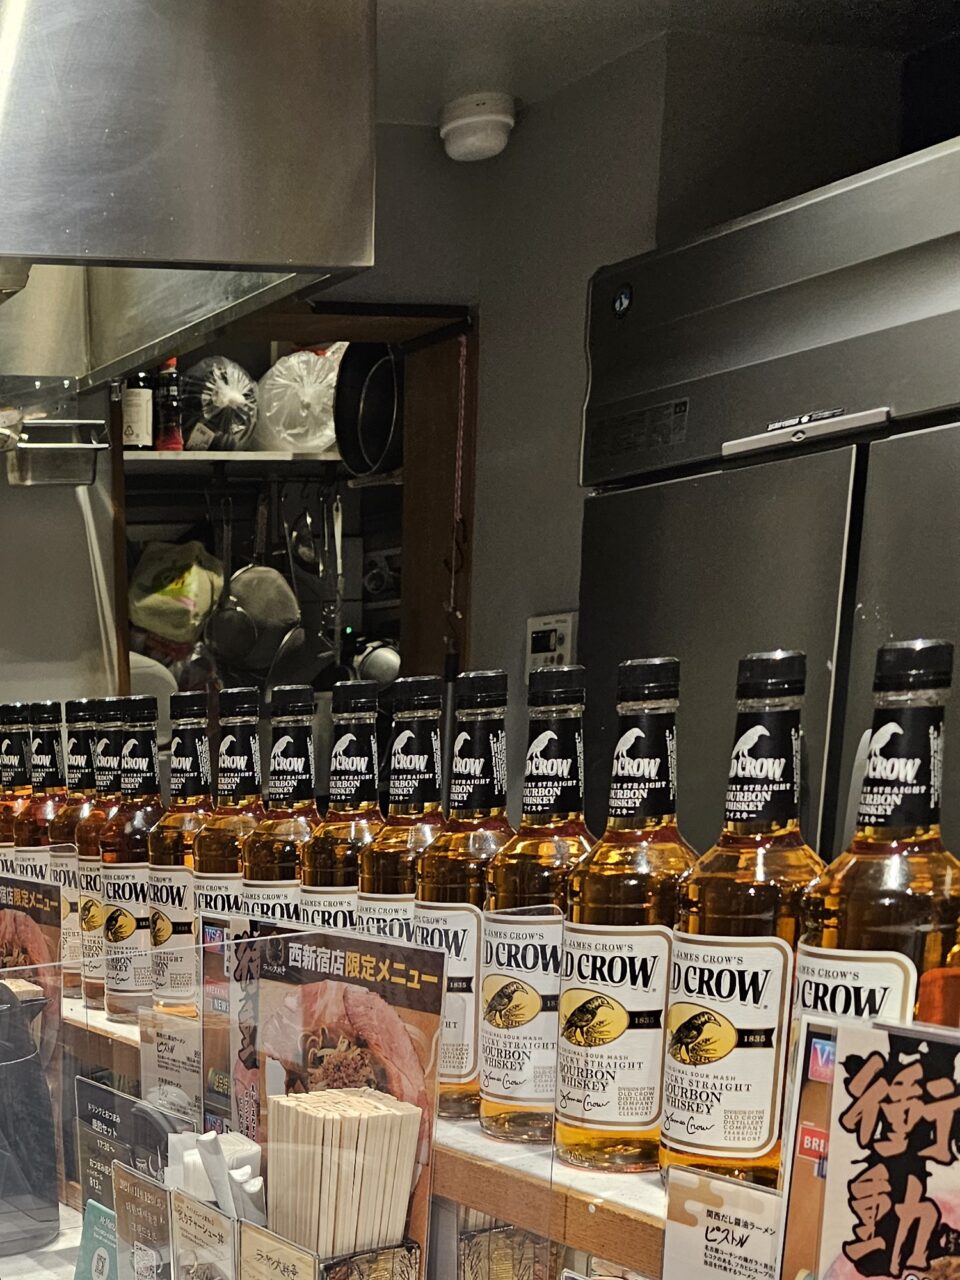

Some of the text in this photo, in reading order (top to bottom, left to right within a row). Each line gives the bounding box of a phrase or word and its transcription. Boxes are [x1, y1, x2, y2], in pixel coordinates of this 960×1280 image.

[338, 755, 369, 773] CROW
[396, 754, 429, 773] CROW
[532, 758, 572, 779] CROW
[619, 758, 661, 780] CROW
[738, 757, 786, 781] CROW
[869, 757, 921, 784] CROW
[510, 931, 544, 941] CROW'S
[595, 943, 634, 952] CROW'S
[288, 941, 439, 991] 西新宿店限定メニュー
[702, 954, 744, 965] CROW'S
[577, 950, 659, 990] CROW
[818, 968, 860, 980] CROW'S
[684, 965, 771, 1008] CROW
[802, 979, 889, 1017] CROW
[743, 1035, 766, 1043] 1835
[583, 1059, 644, 1070] STRAIGHT
[688, 1079, 753, 1093] STRAIGHT
